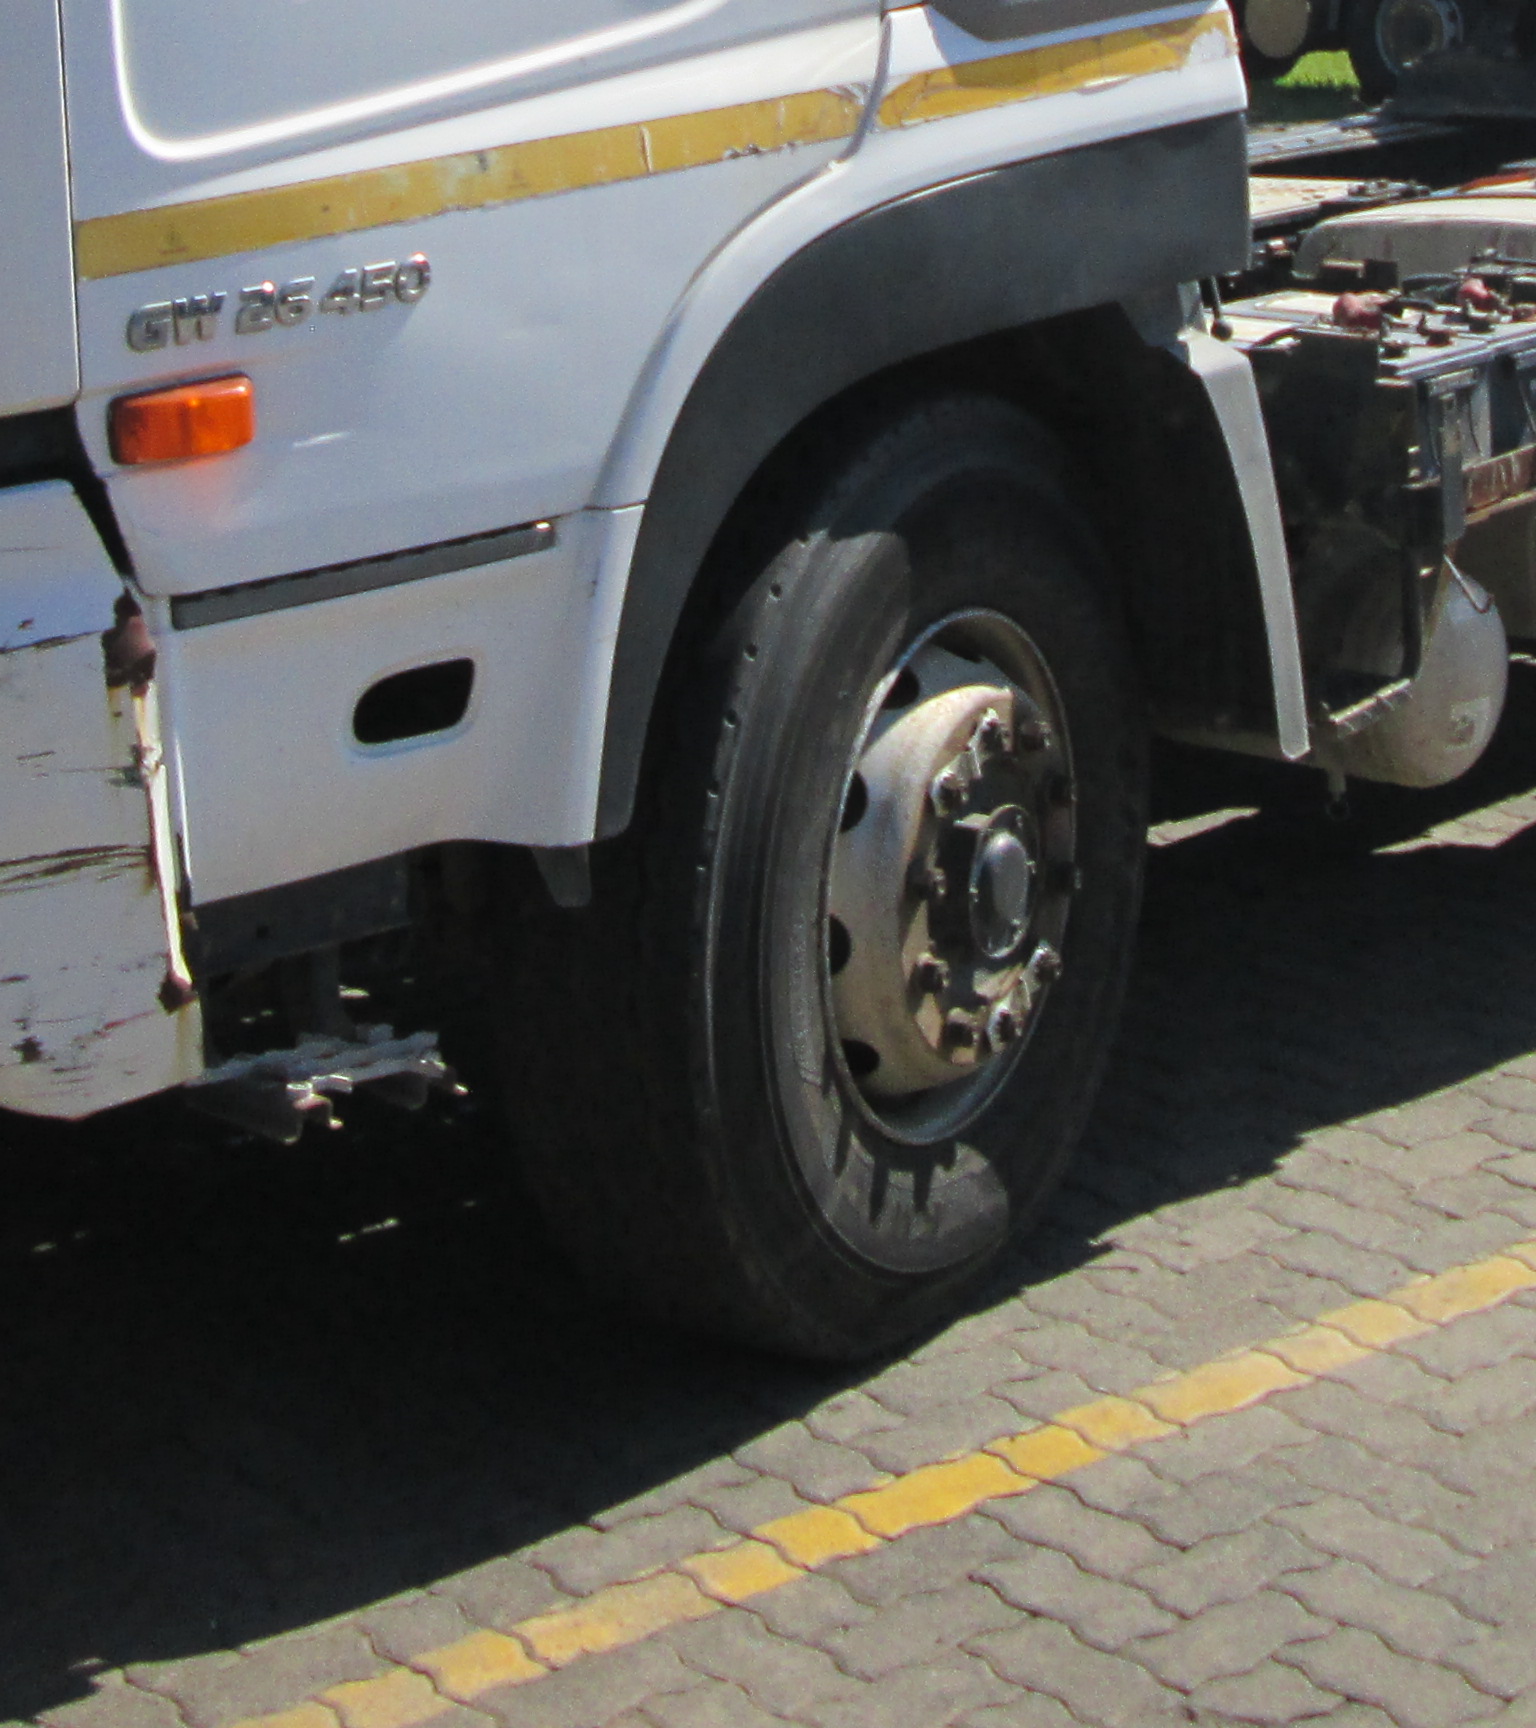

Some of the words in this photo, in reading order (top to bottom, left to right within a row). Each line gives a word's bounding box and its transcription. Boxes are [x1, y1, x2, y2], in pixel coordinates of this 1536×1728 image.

[126, 290, 228, 355] GW
[234, 275, 315, 336] 26
[318, 252, 432, 316] 450
